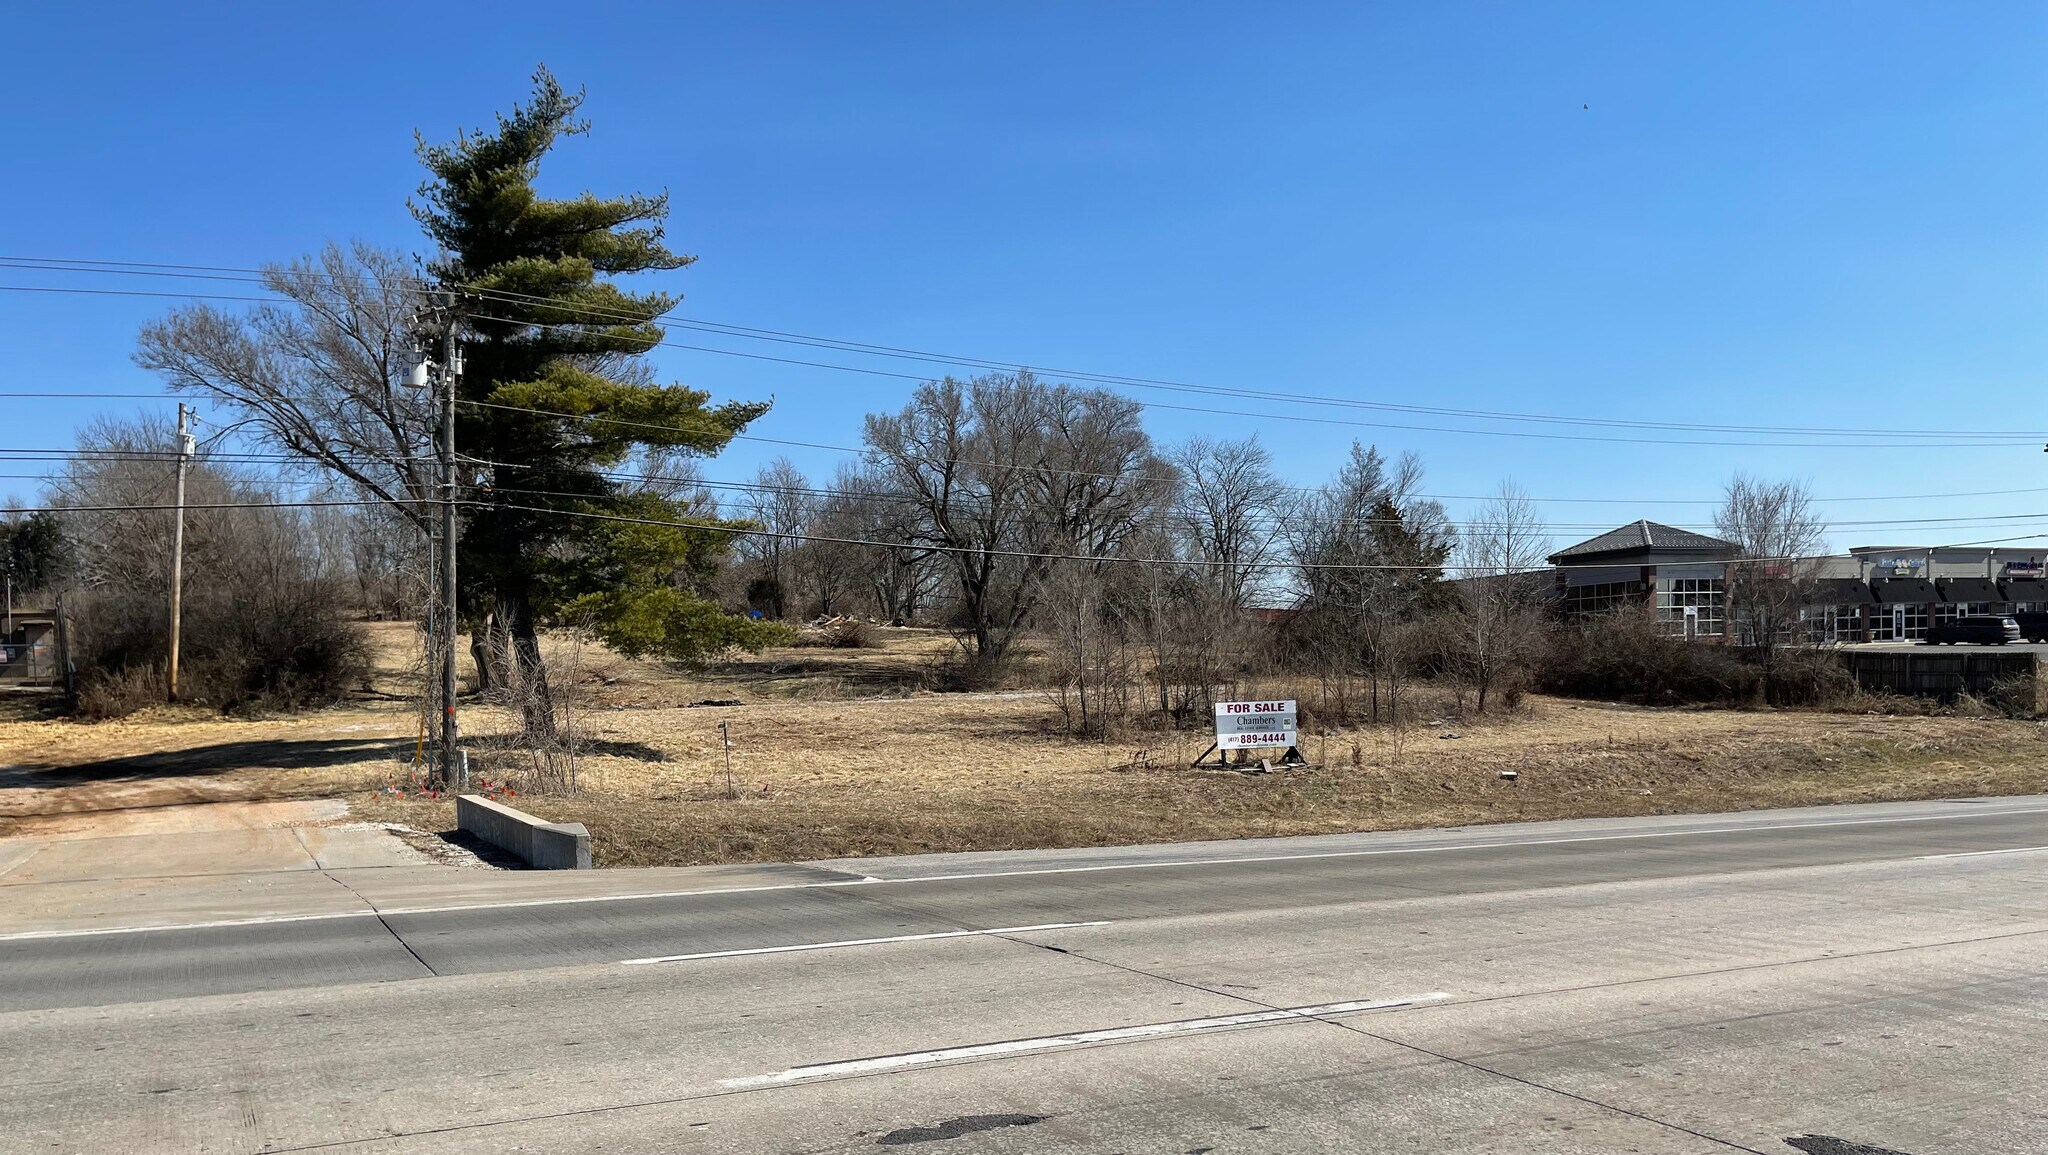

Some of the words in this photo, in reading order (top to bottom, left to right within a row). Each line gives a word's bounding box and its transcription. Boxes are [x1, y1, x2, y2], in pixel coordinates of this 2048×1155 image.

[1227, 704, 1250, 713] FOR
[1254, 703, 1285, 712] SALE
[1236, 715, 1276, 725] Chambers
[1240, 733, 1286, 744] 889-4444
